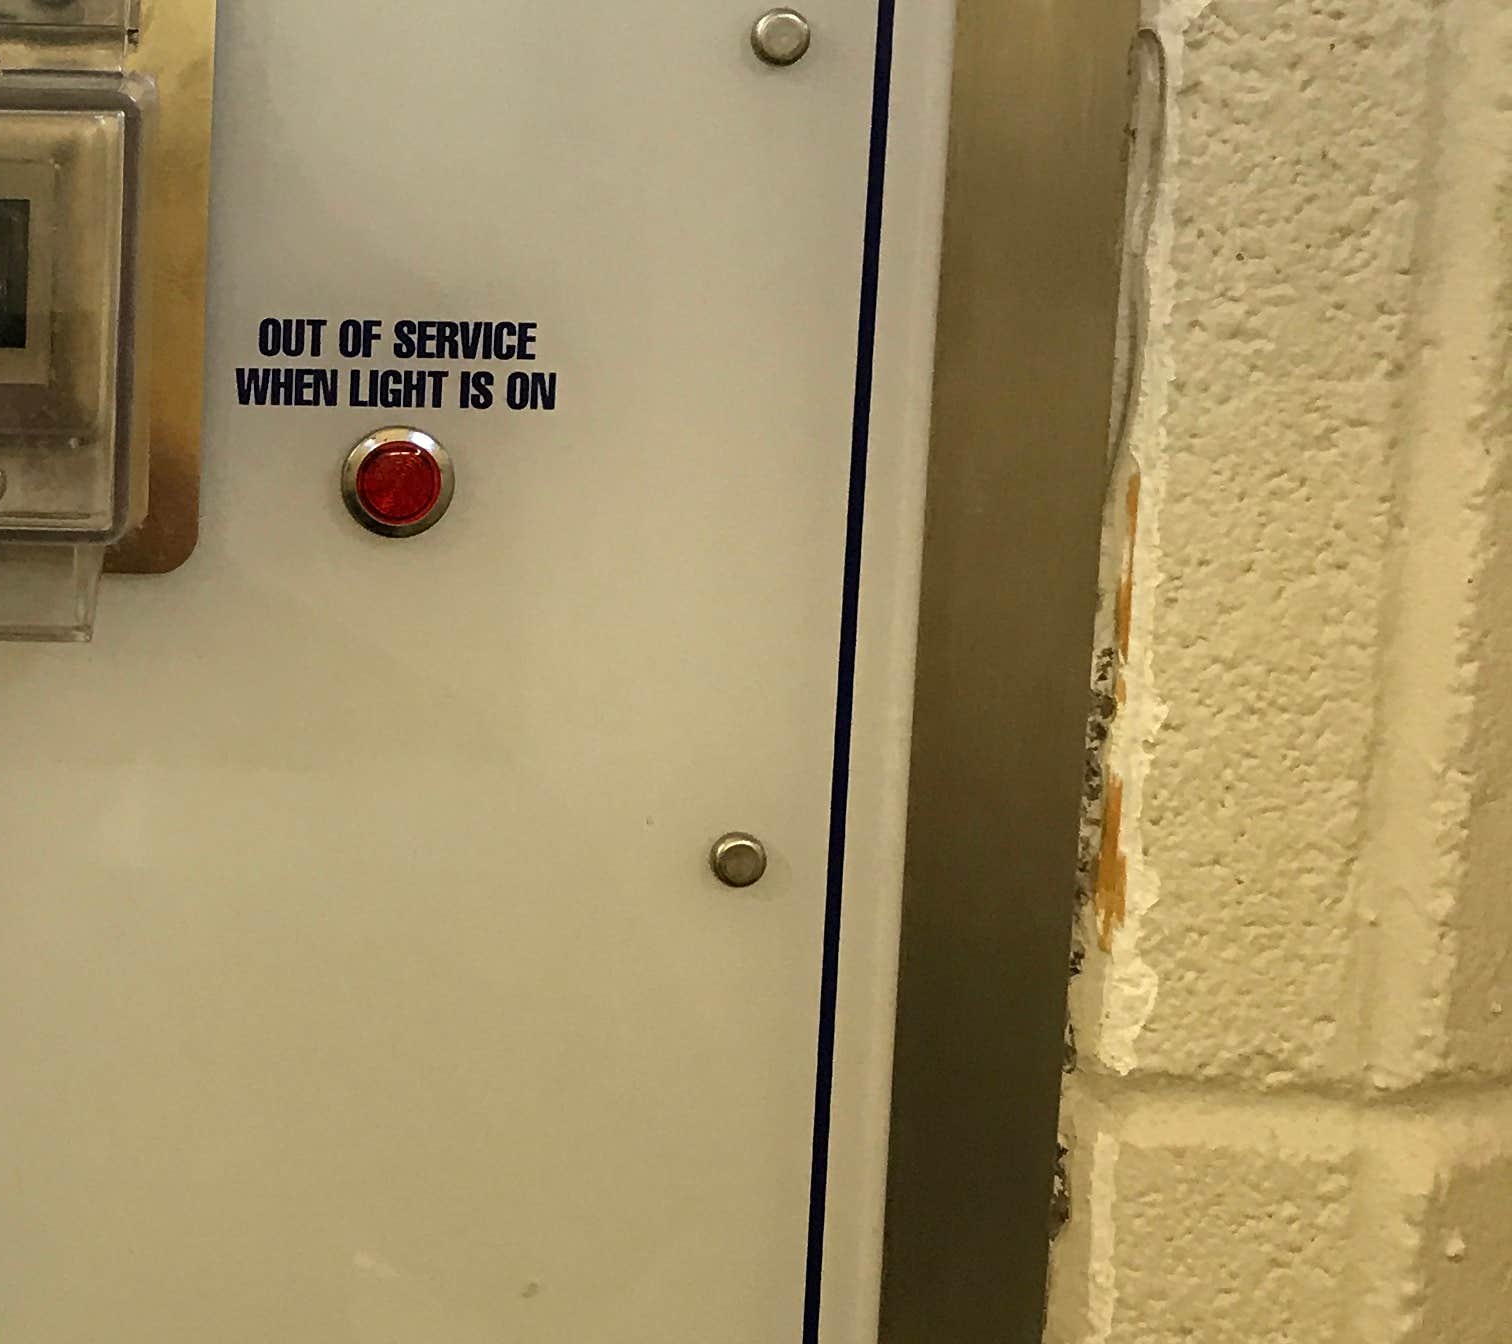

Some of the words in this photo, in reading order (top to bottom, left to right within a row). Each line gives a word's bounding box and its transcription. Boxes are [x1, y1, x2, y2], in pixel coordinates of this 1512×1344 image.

[258, 317, 328, 358] OUT
[338, 318, 383, 359] OF
[393, 319, 538, 361] SERVICE
[235, 367, 339, 407] WHEN
[348, 368, 450, 409] LIGHT
[459, 370, 495, 410] IS
[506, 371, 557, 411] ON
